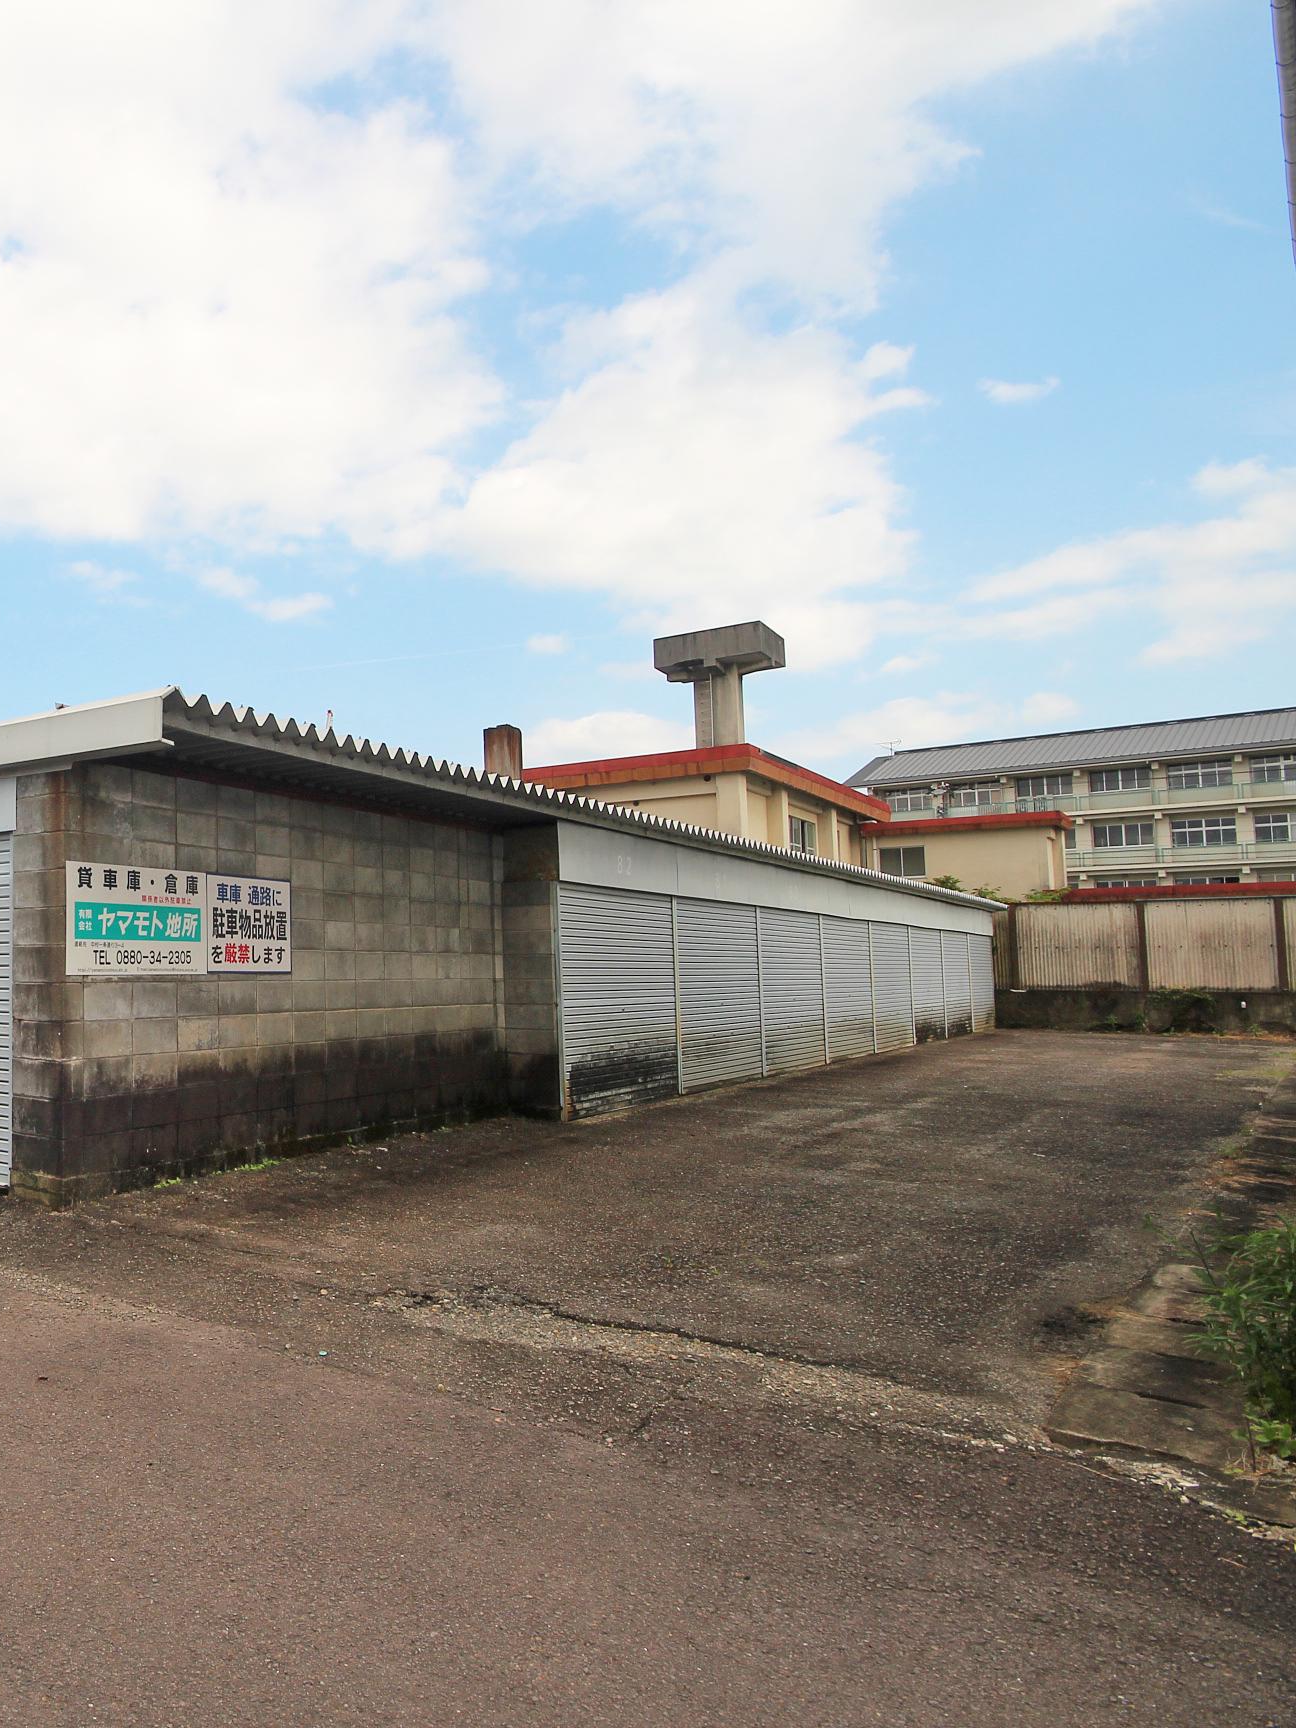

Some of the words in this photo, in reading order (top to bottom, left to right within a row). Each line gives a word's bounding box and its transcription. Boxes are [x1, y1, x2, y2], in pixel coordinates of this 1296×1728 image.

[617, 855, 633, 877] 82
[77, 866, 199, 896] 貸車庫・倉庫
[216, 882, 242, 905] 車庫
[248, 885, 282, 906] 通路に
[97, 907, 199, 938] ヤマモト地所
[212, 907, 287, 941] 駐車物品放置
[93, 949, 111, 965] TEL
[116, 950, 192, 965] 0880-34-2305
[211, 943, 285, 964] を厳禁します
